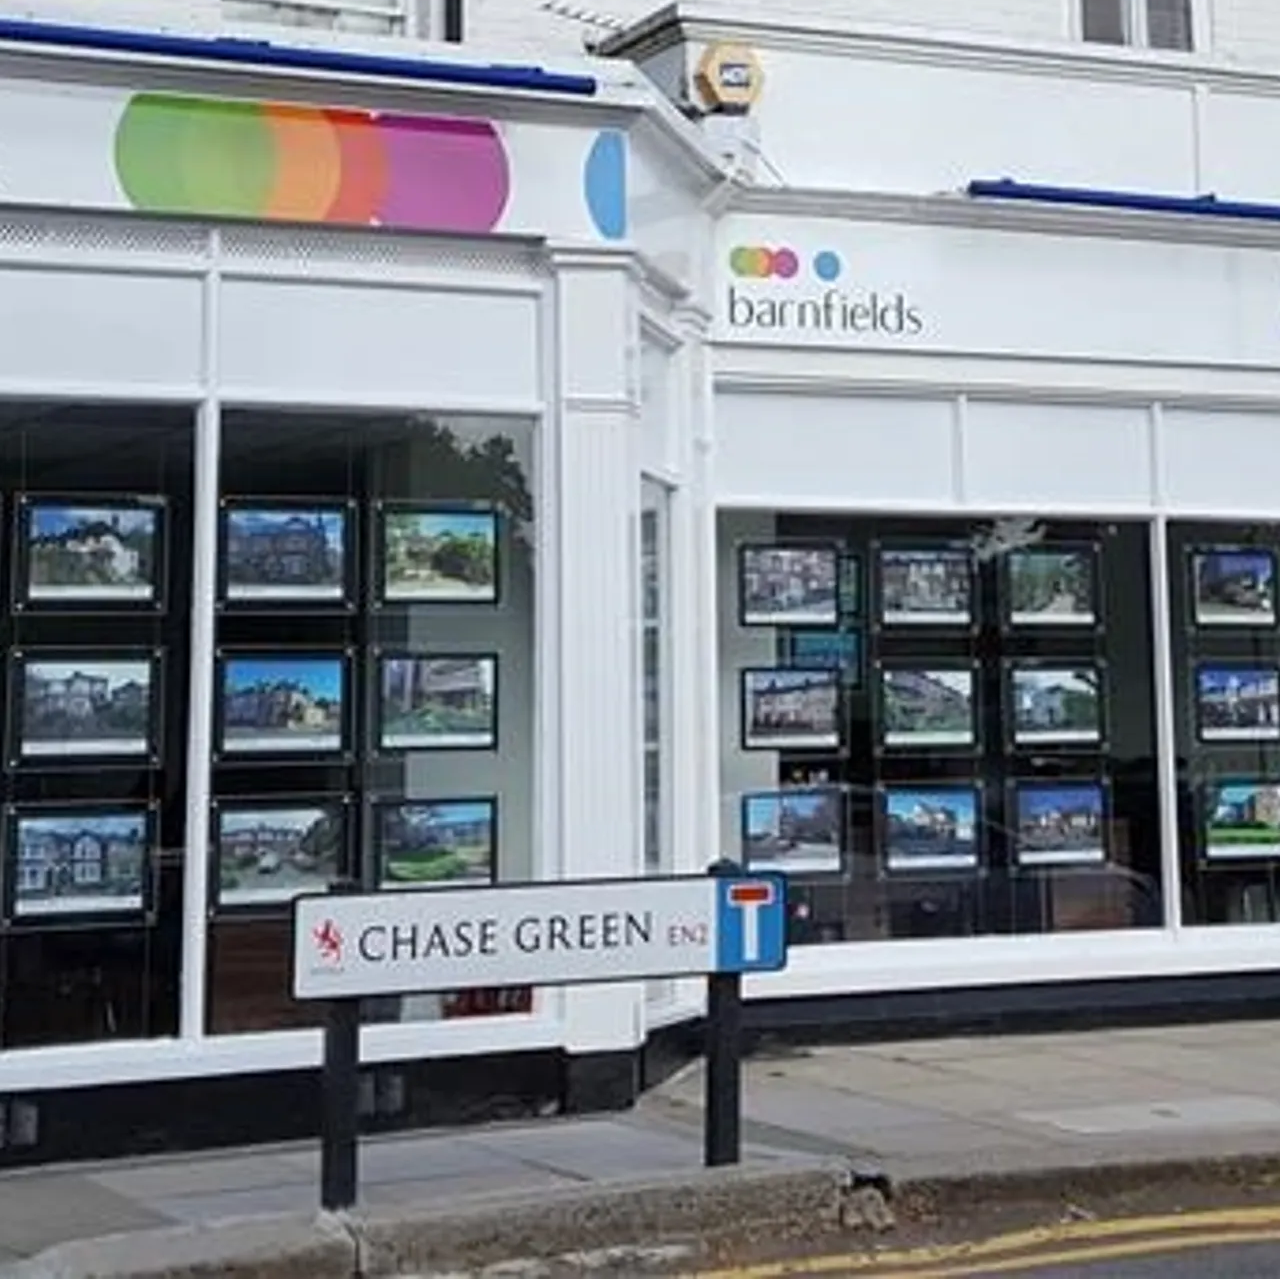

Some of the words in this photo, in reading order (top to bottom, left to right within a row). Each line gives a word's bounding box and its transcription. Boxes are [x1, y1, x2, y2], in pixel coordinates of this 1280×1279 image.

[728, 286, 923, 334] barnfields
[358, 918, 498, 962] CHASE
[514, 910, 653, 954] GREEN
[667, 923, 709, 946] EN2
